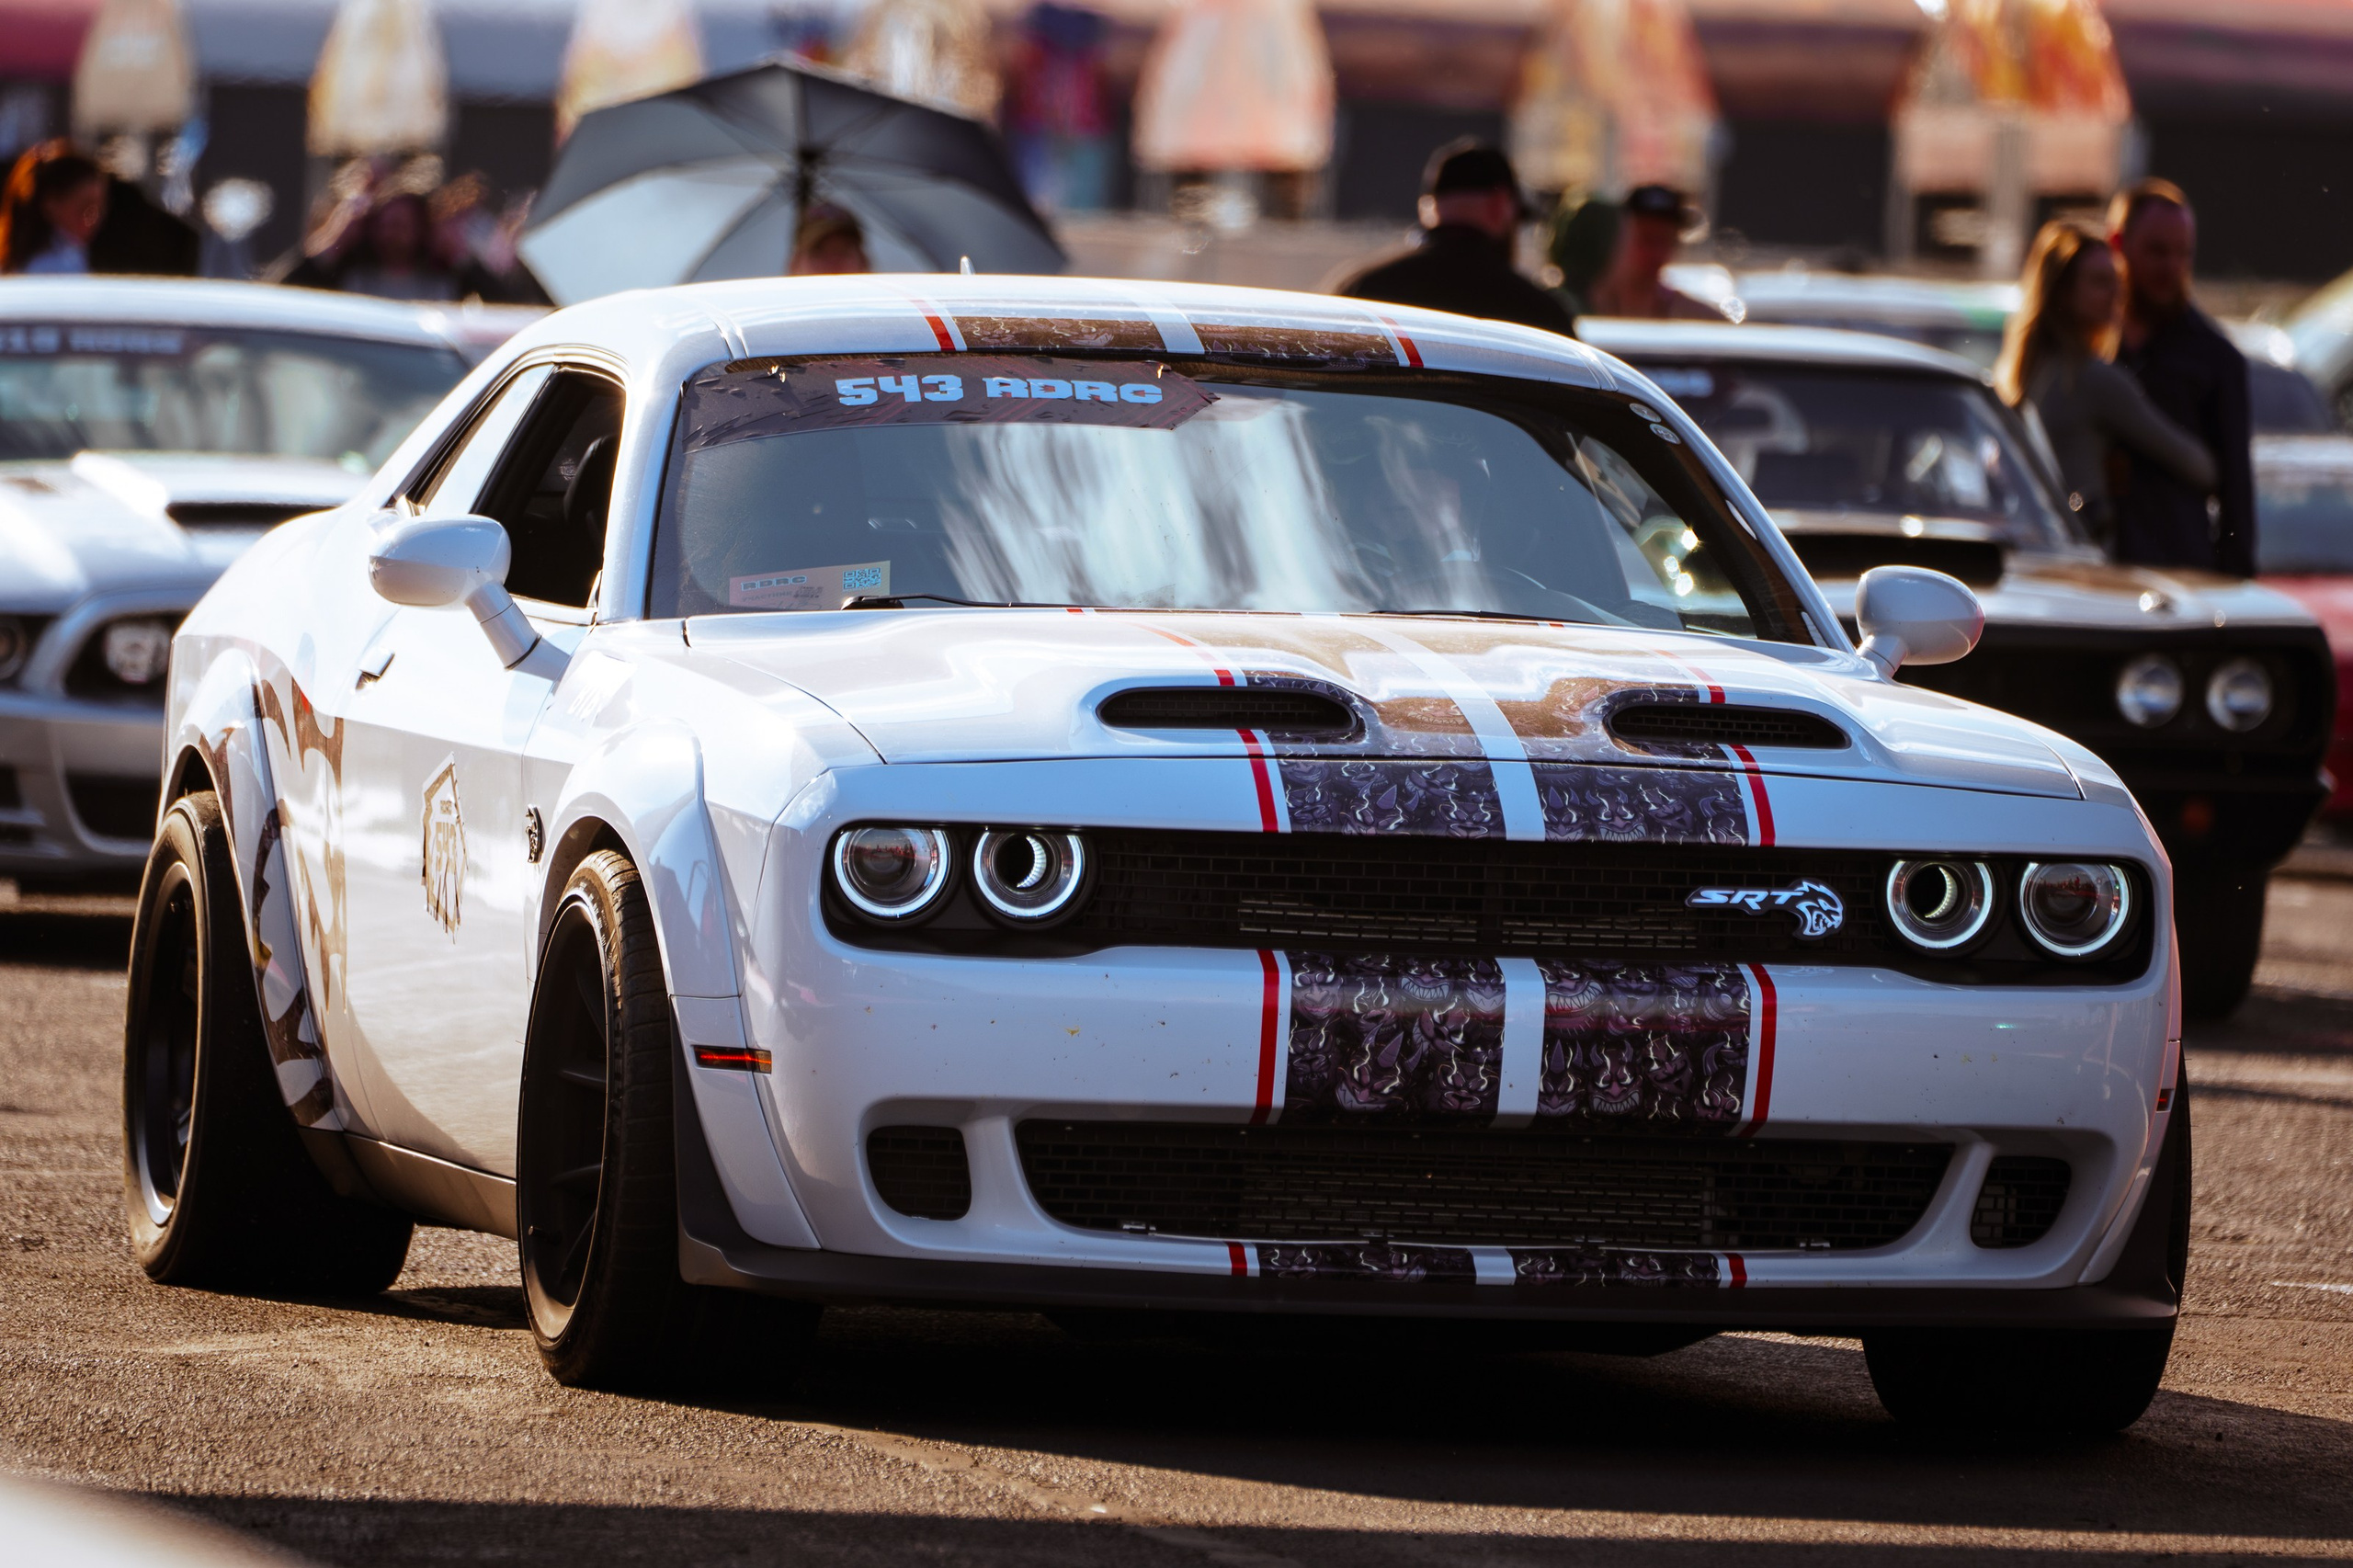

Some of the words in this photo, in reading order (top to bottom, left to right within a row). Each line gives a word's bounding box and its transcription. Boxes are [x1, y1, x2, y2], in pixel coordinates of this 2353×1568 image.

[835, 374, 964, 406] 543
[983, 376, 1163, 404] RDRC
[741, 575, 807, 591] RDRC
[435, 821, 458, 875] 543
[1691, 890, 1804, 910] SRT
